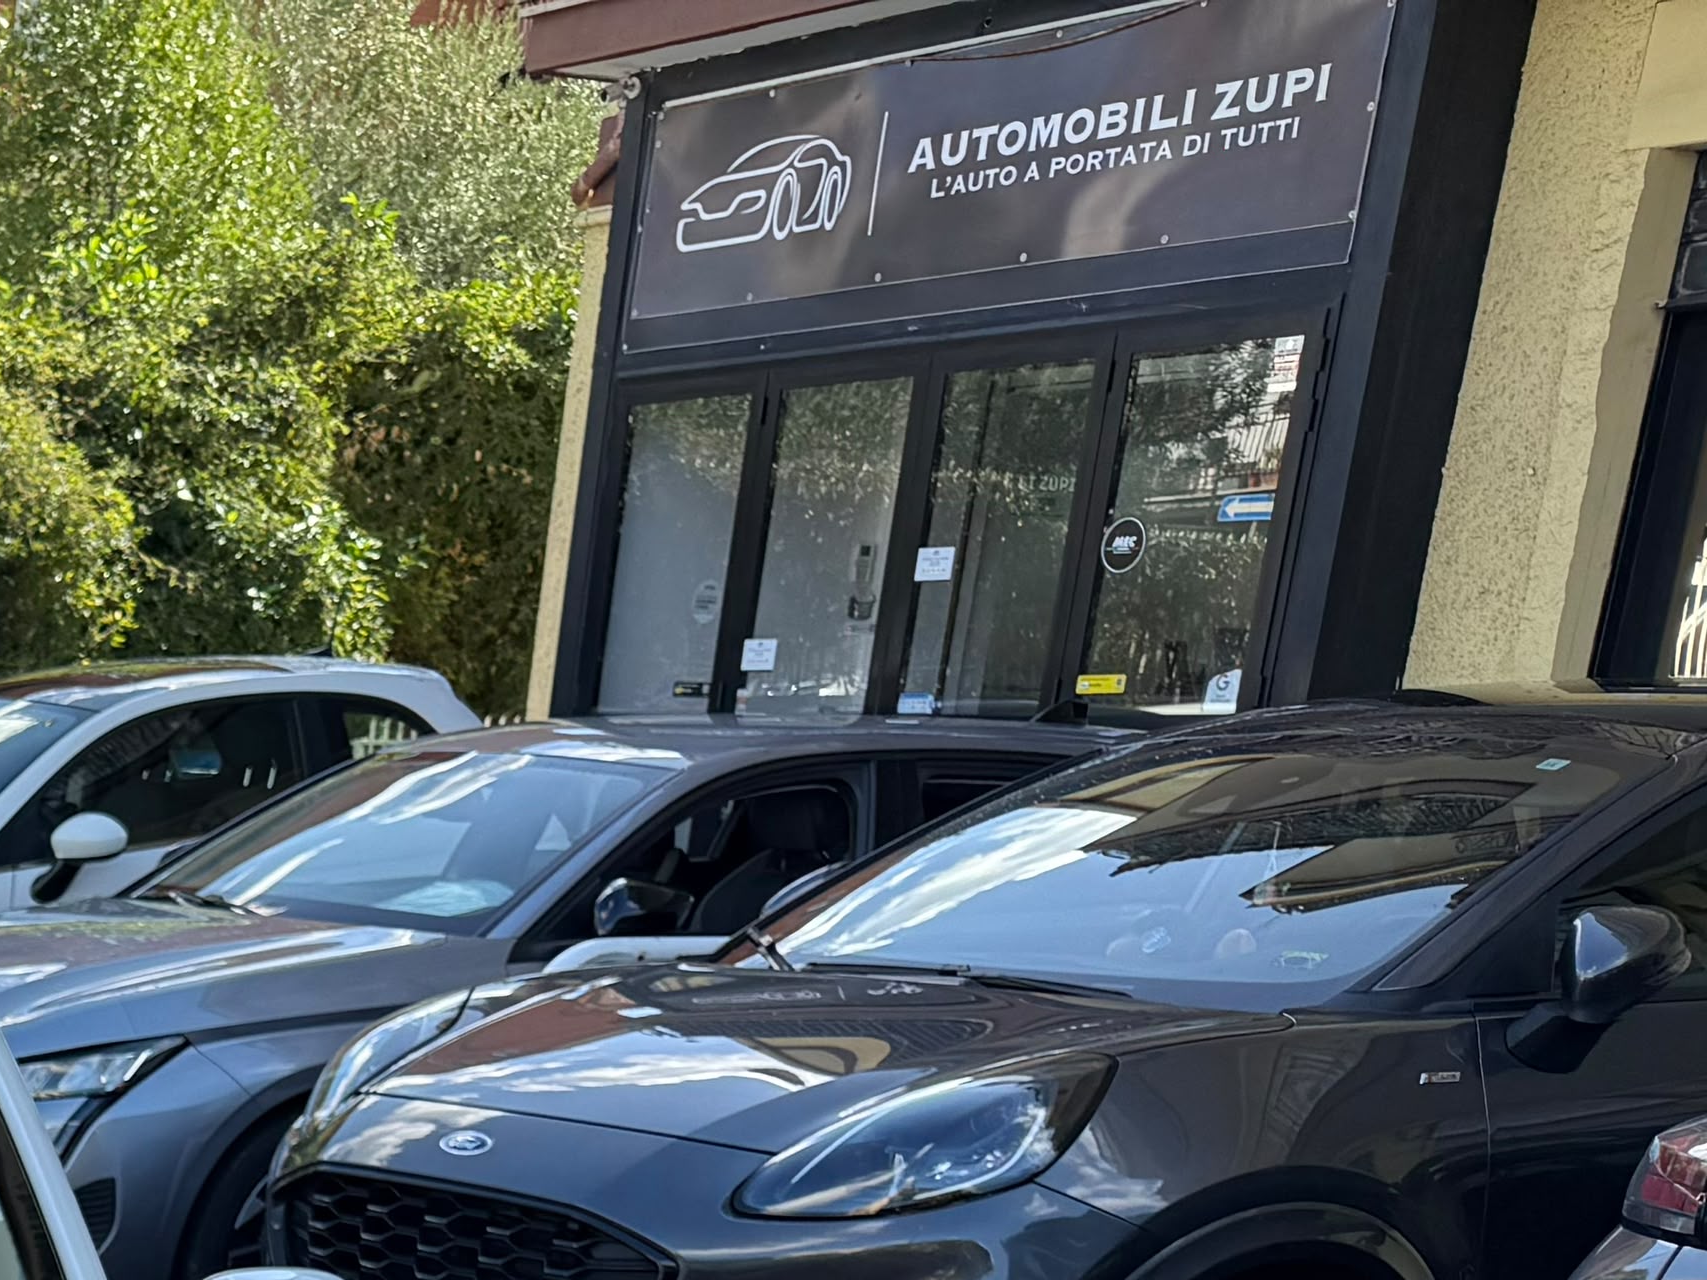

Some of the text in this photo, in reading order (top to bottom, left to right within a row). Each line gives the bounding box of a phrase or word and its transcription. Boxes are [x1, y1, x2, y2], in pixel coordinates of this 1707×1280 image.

[907, 63, 1333, 174] AUTOMOBILI ZUPI
[930, 116, 1301, 198] L'AUTO A PORTATA DI TUTTI
